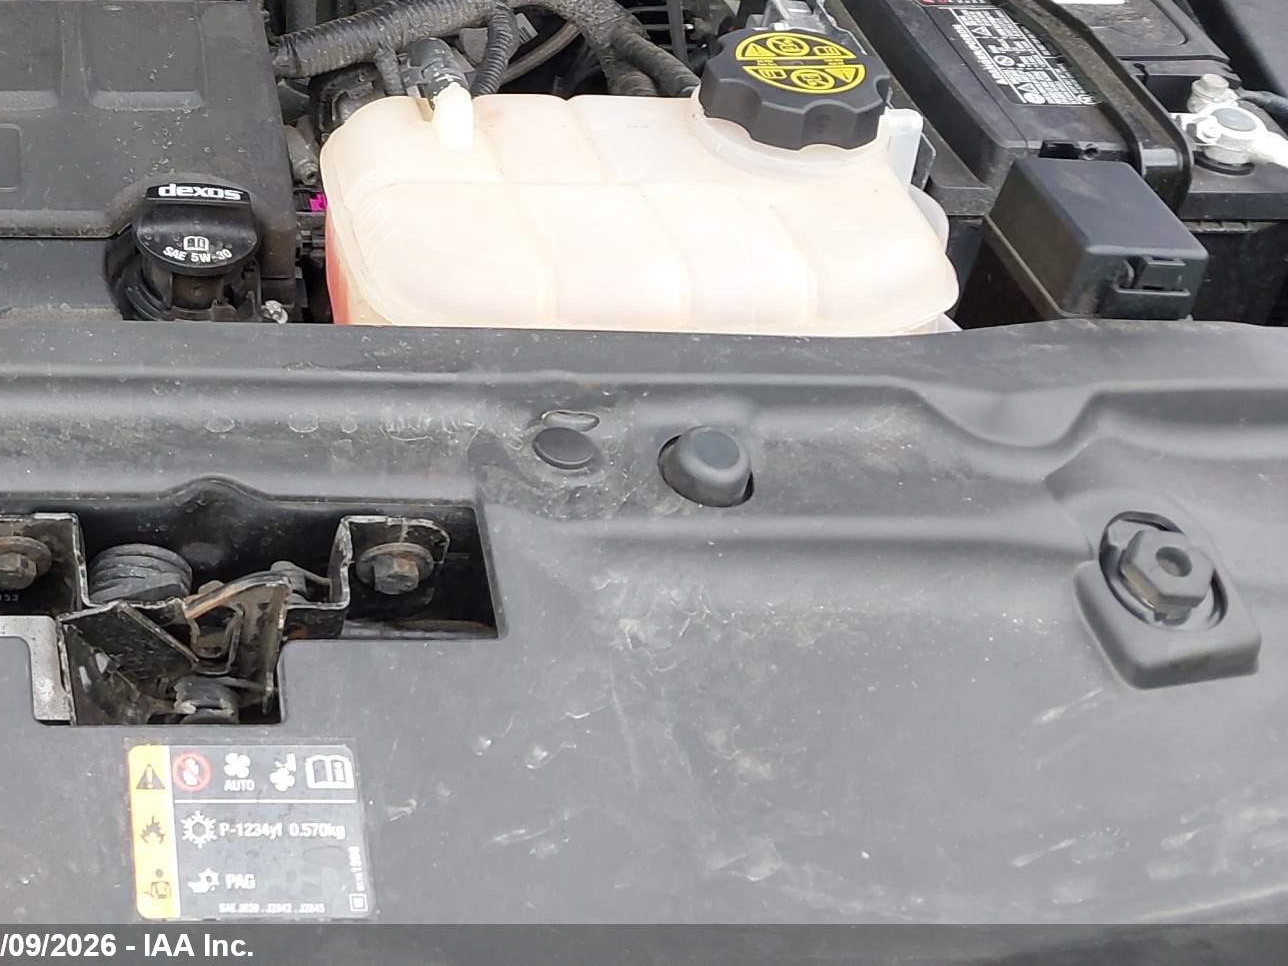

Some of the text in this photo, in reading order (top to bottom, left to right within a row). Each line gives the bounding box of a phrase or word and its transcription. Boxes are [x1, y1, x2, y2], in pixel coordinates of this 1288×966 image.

[158, 183, 241, 200] dexos
[163, 246, 232, 263] SAE 5W-30
[223, 779, 255, 792] AUTO
[225, 873, 256, 890] PAG
